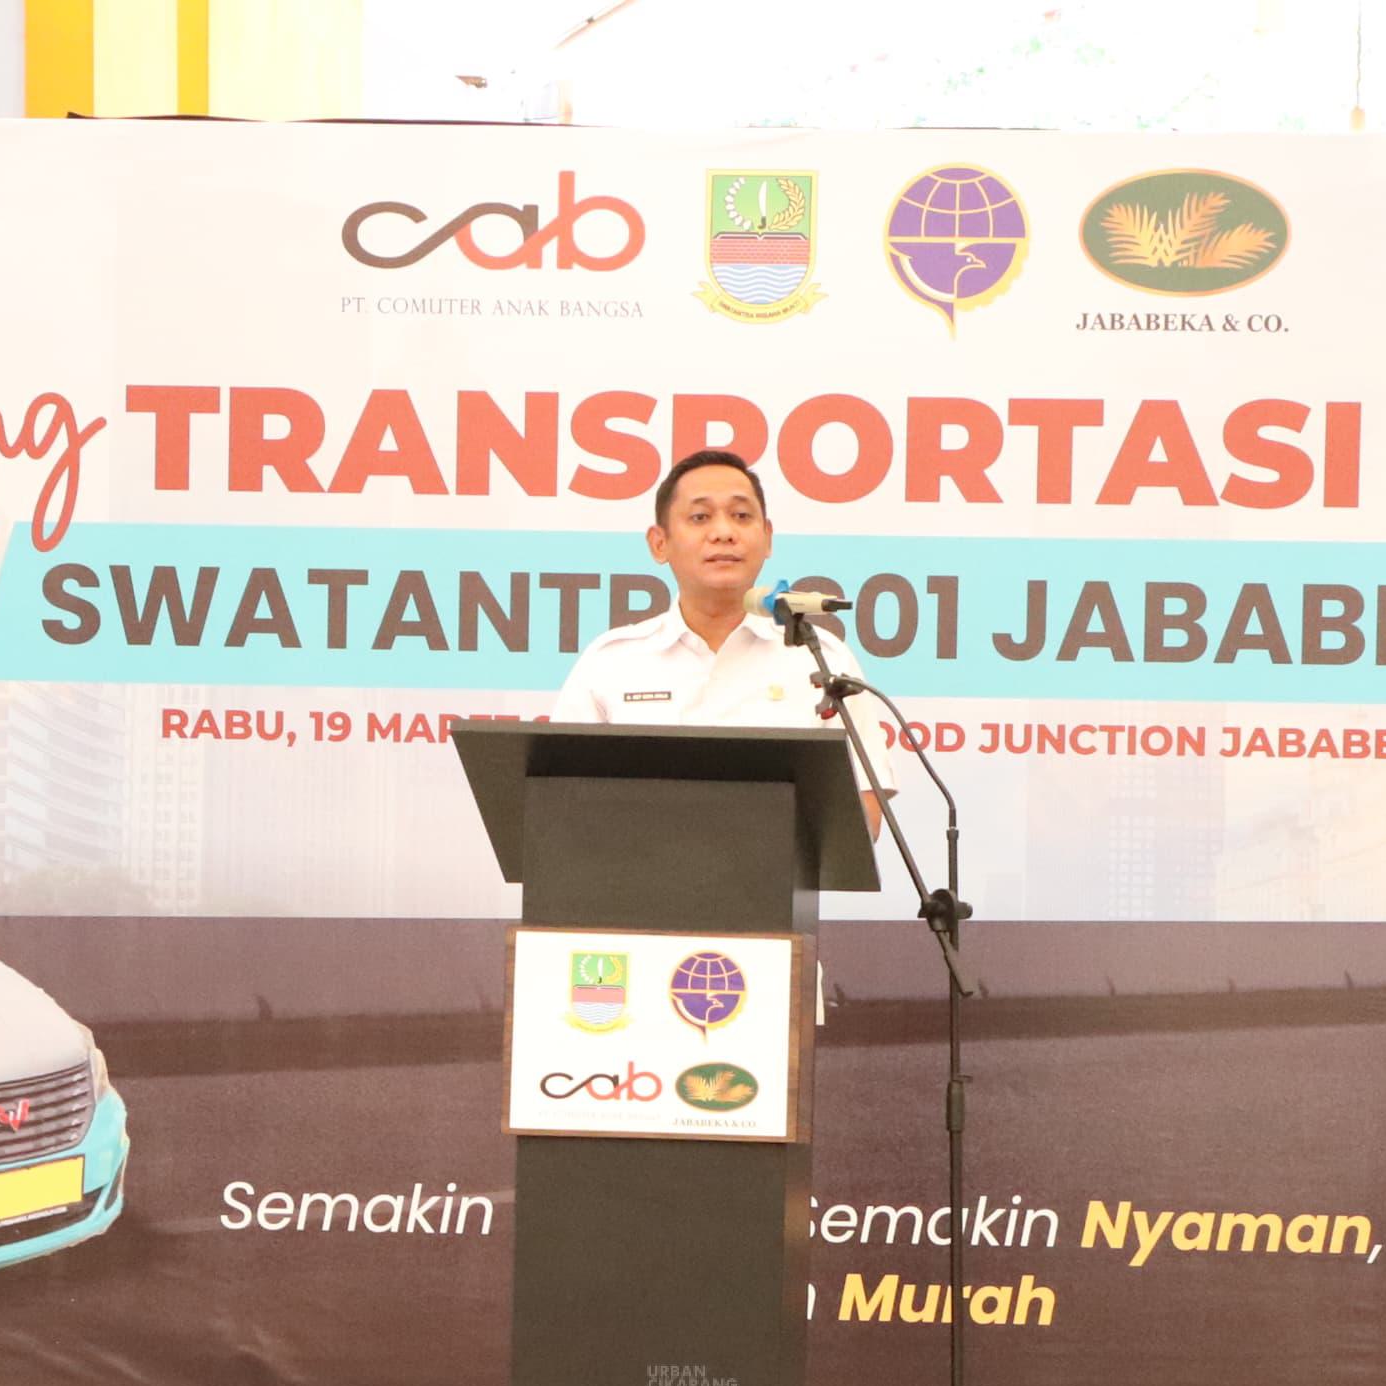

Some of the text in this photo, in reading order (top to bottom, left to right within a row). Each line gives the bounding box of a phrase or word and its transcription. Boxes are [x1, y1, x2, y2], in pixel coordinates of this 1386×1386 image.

[341, 170, 647, 273] cab
[377, 298, 483, 317] COMUTER
[493, 300, 551, 318] ANAK
[559, 300, 644, 319] BANGSA
[1076, 312, 1290, 334] JABABEKA & CO.
[125, 384, 1364, 510] TRANSPORTASI
[161, 708, 297, 748] RABU,
[310, 711, 353, 744] 19
[979, 722, 1208, 759] JUNCTION
[540, 1061, 664, 1103] cab
[219, 1181, 494, 1236] Semakin
[1080, 1200, 1384, 1268] Nyaman,
